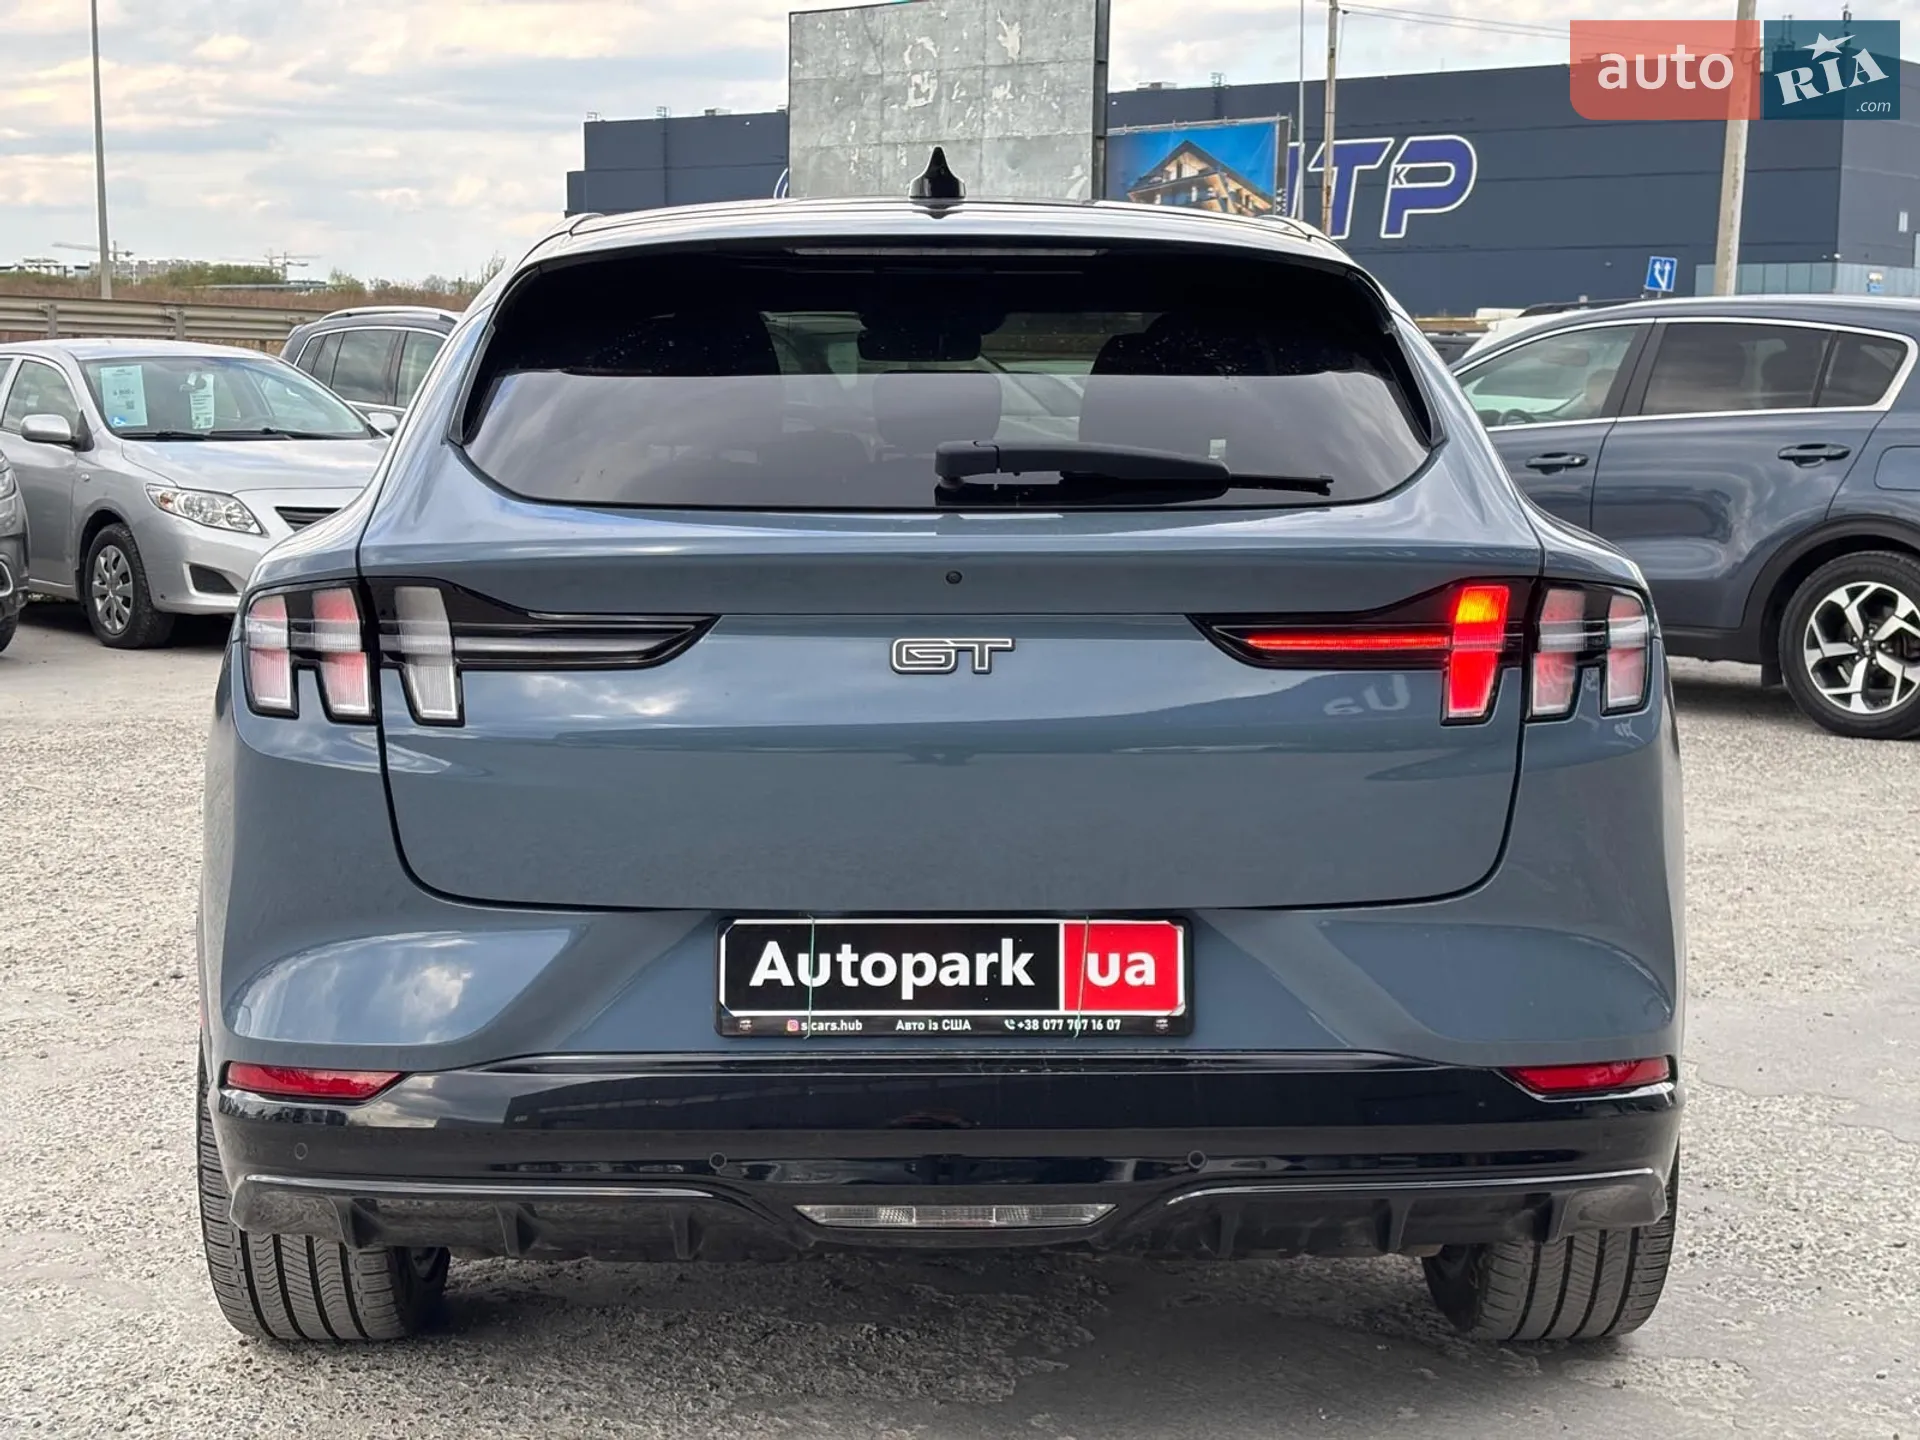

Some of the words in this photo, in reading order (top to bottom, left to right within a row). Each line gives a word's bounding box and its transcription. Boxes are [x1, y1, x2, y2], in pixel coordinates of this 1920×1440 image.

[892, 638, 1014, 672] GT
[749, 938, 1035, 1000] Autopark
[1086, 951, 1156, 987] ua
[895, 1019, 925, 1031] Авто
[928, 1019, 939, 1031] із
[941, 1019, 972, 1031] США
[1017, 1019, 1040, 1031] +38
[1042, 1019, 1064, 1031] 077
[1091, 1019, 1104, 1031] 16
[1106, 1019, 1121, 1031] 07
